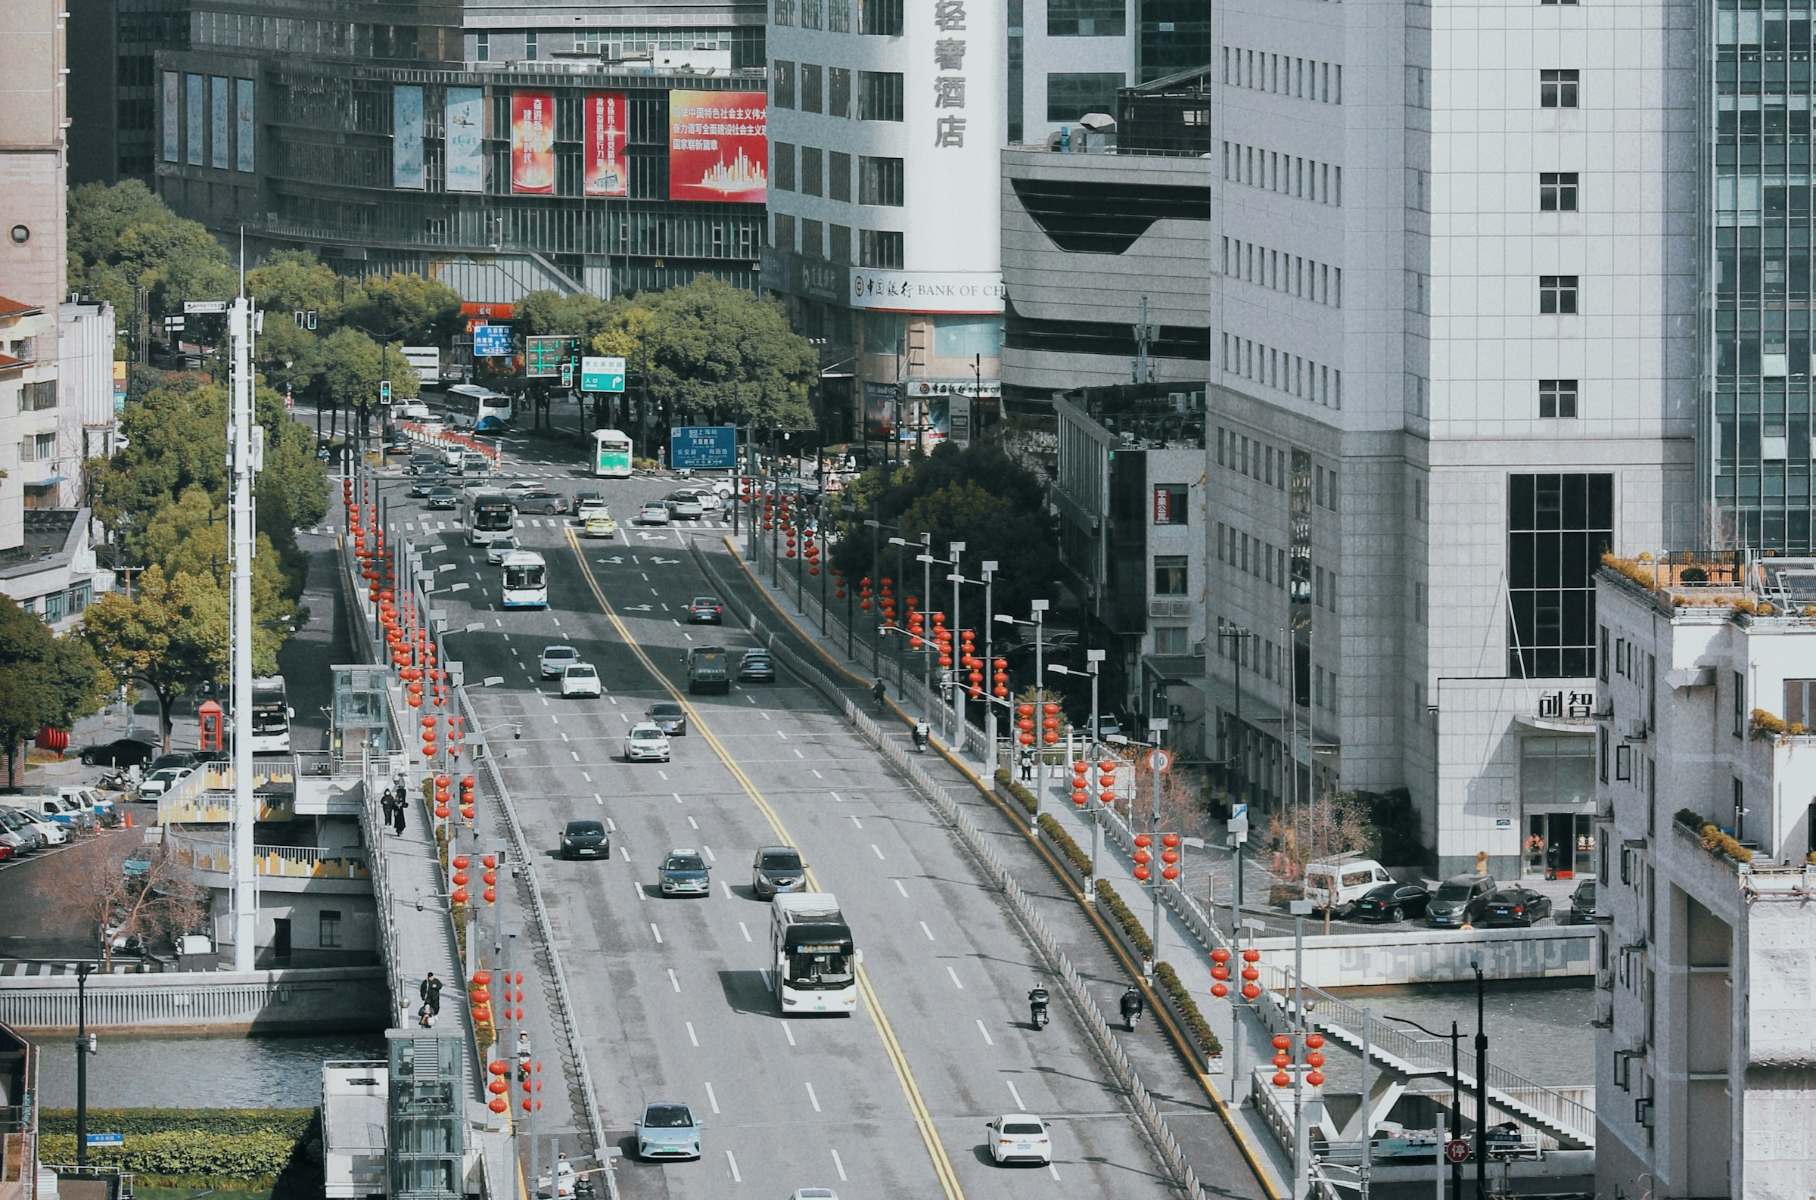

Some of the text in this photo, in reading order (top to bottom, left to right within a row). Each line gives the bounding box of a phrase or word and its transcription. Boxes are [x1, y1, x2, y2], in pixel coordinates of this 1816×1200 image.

[934, 0, 967, 148] 轻奢酒店
[673, 139, 718, 151] 国家崭新篇章
[867, 278, 914, 299] 中国银行
[918, 285, 956, 297] BANK
[959, 286, 978, 297] OF
[1537, 690, 1593, 718] 创智
[1451, 1144, 1465, 1158] 停
